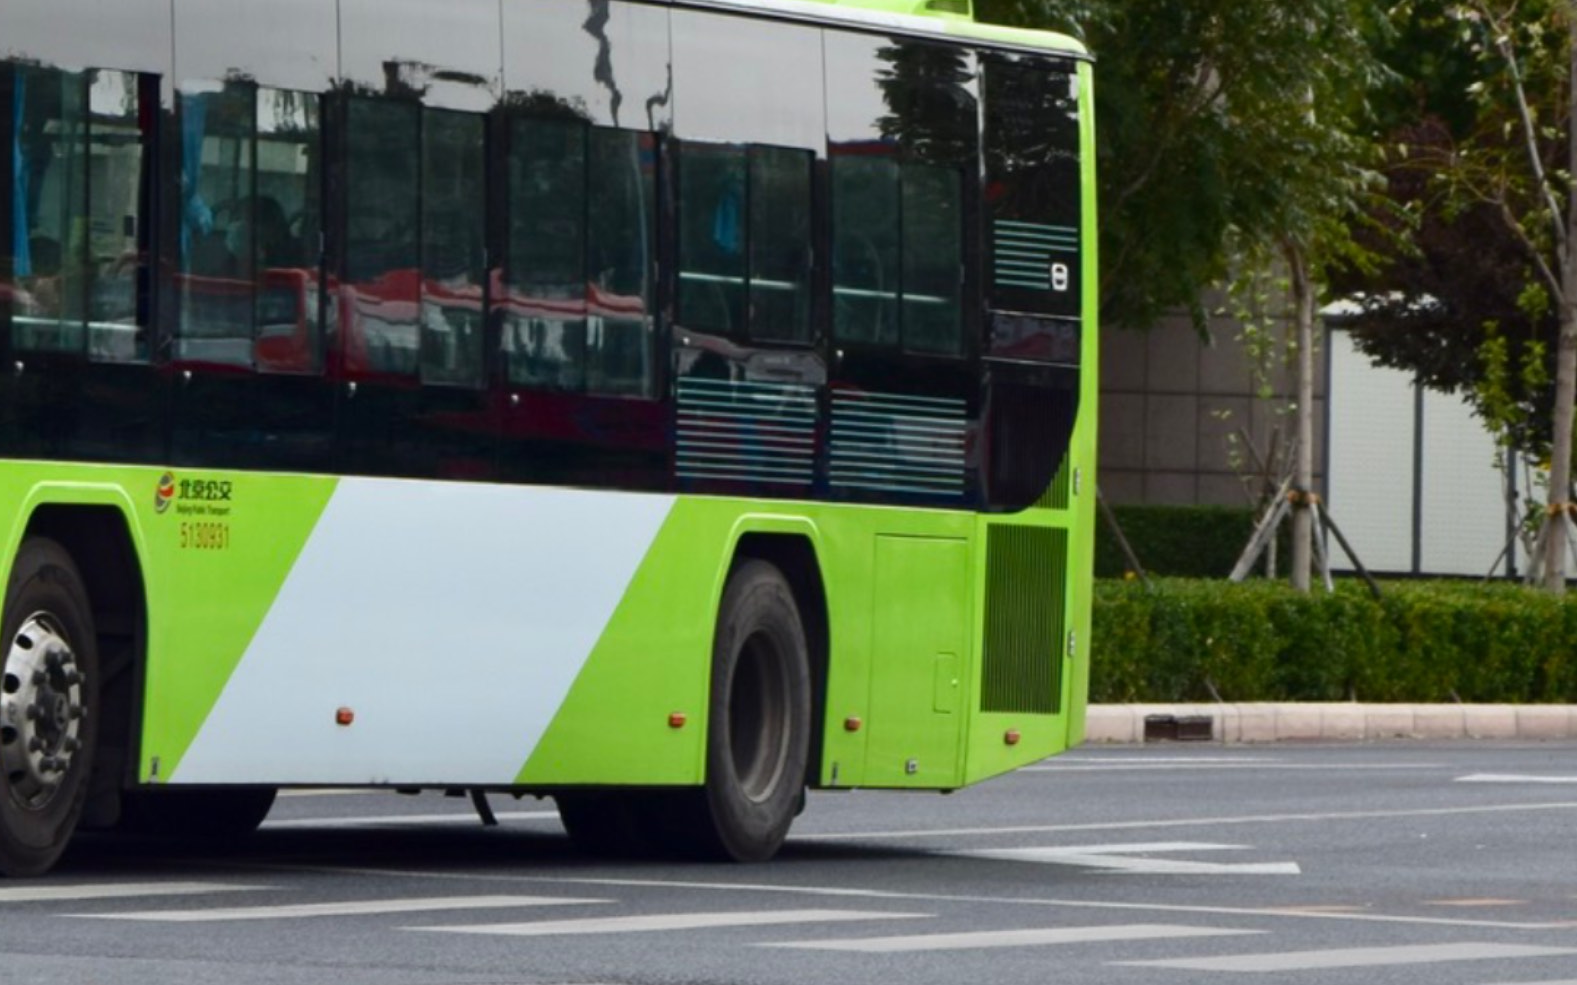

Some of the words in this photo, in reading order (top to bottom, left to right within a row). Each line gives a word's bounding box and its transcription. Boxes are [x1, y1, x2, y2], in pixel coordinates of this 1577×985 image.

[178, 479, 232, 501] 北京公交
[180, 521, 229, 549] 5130931
